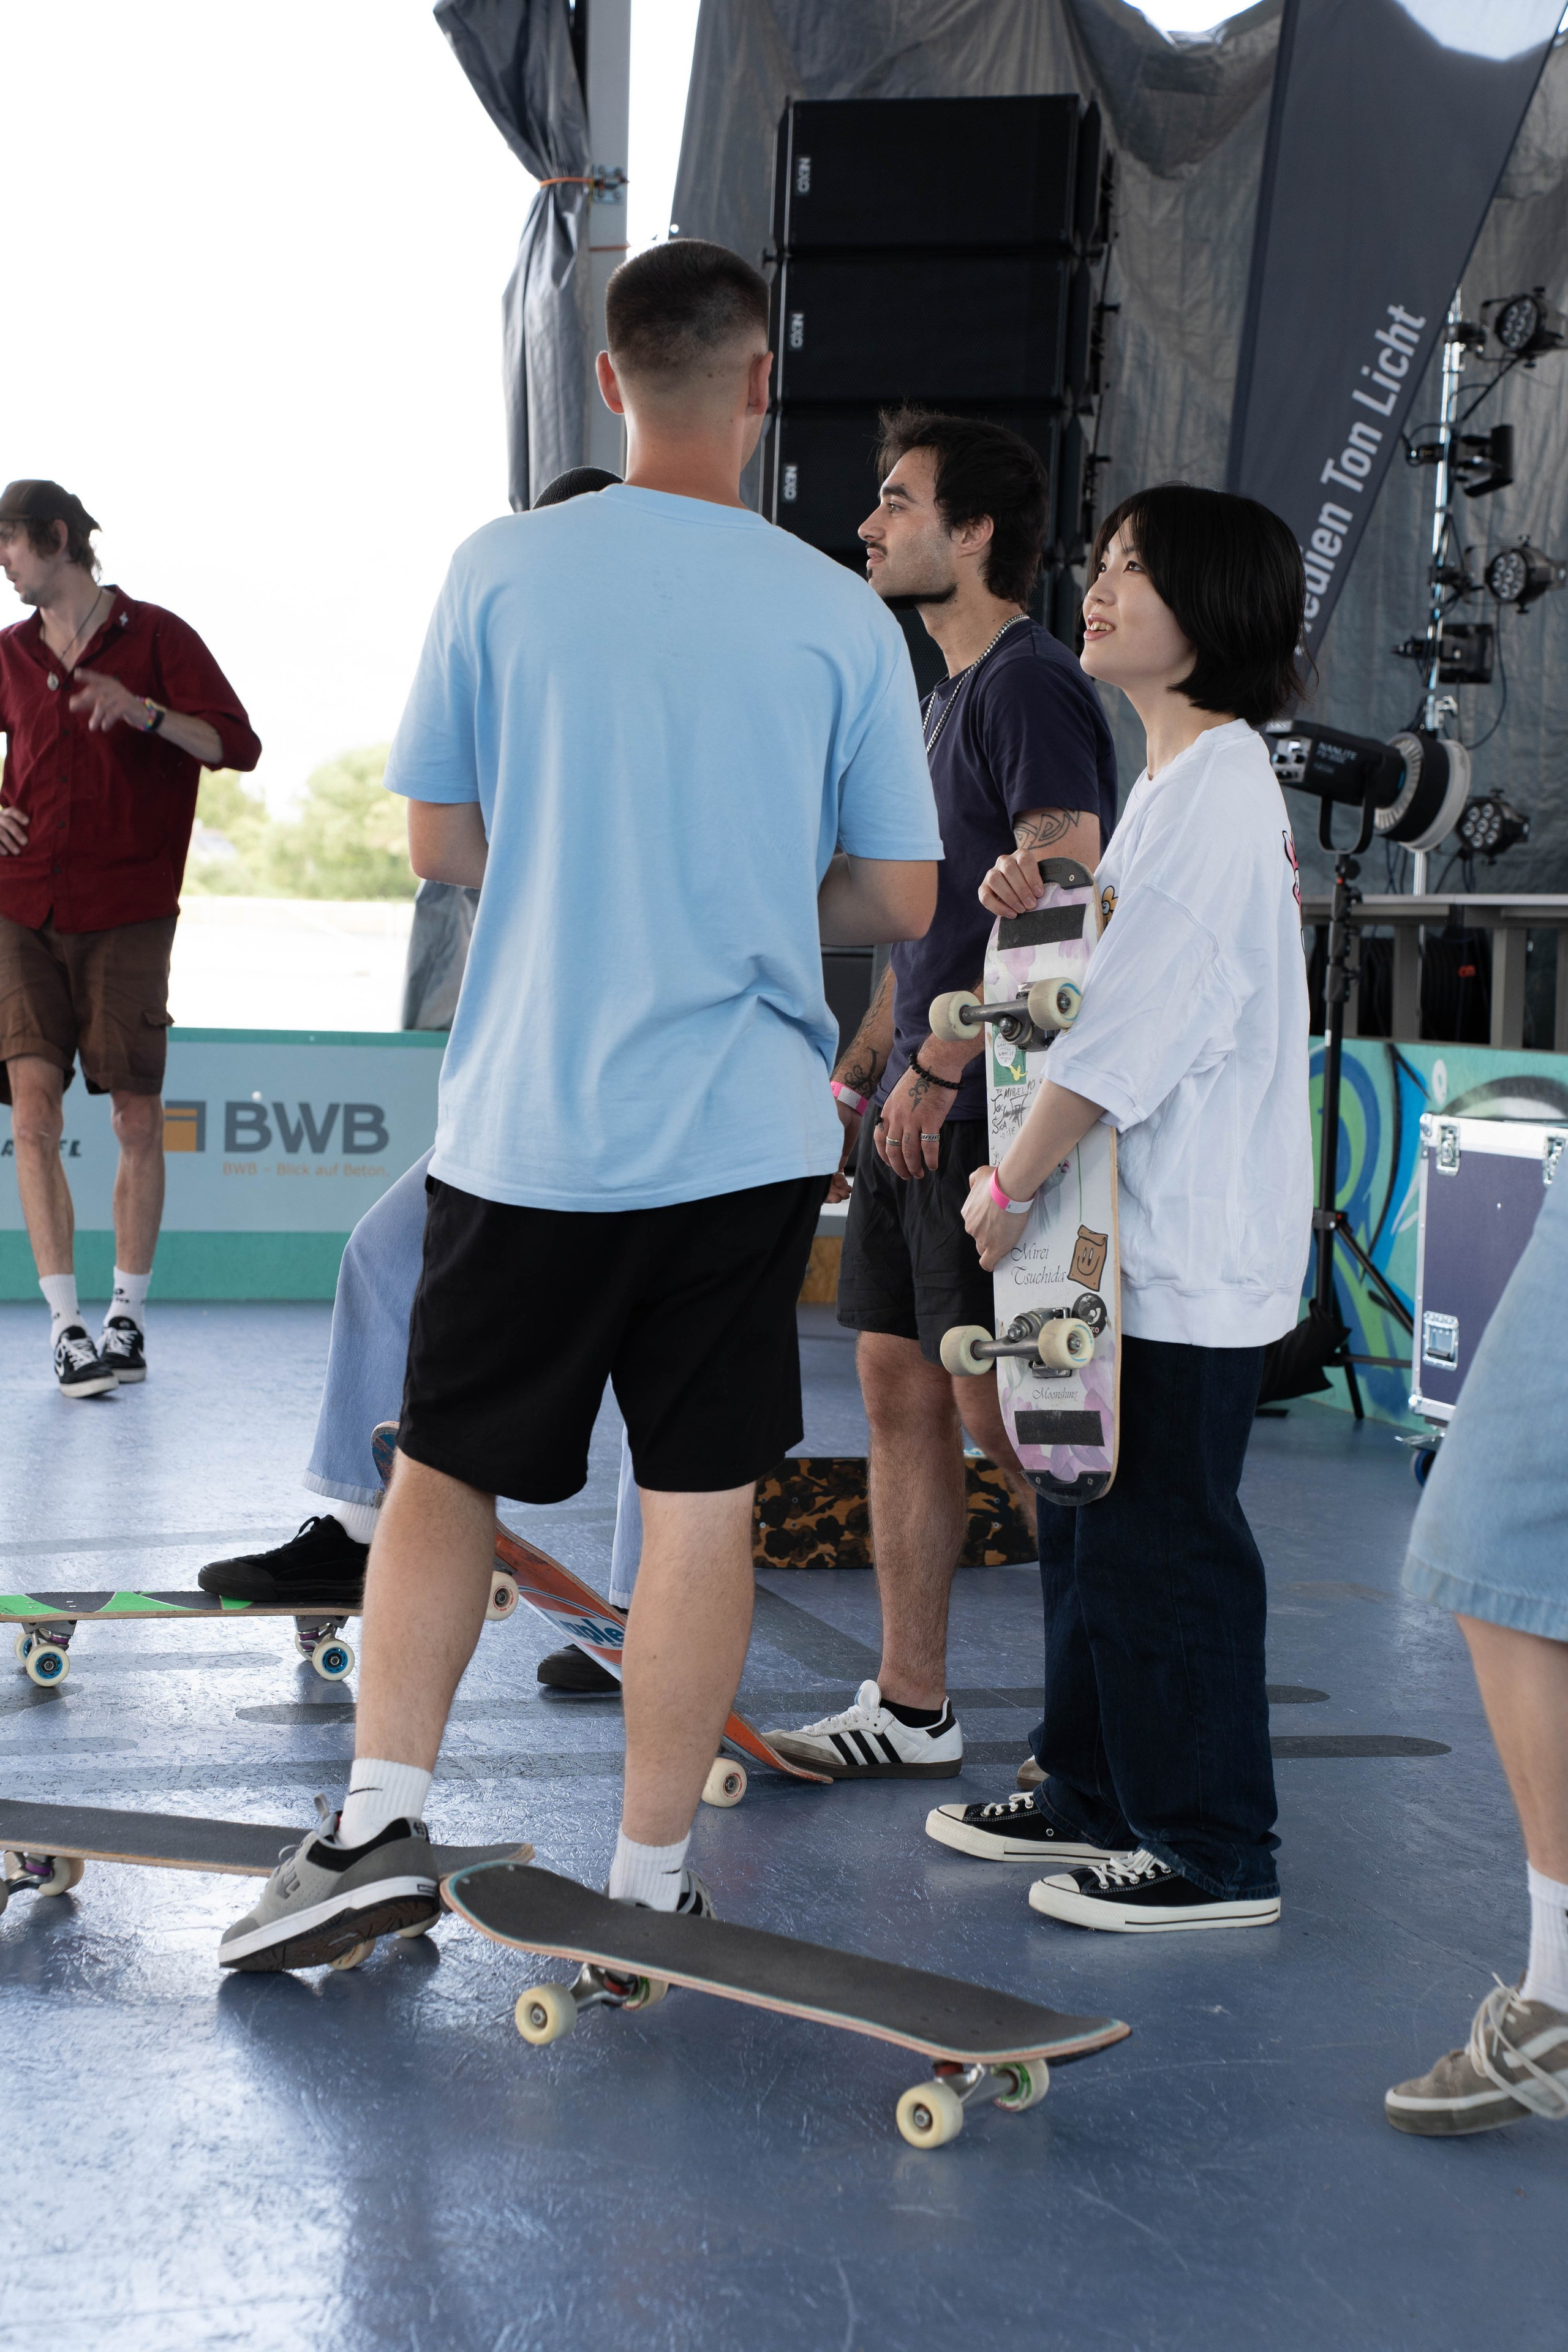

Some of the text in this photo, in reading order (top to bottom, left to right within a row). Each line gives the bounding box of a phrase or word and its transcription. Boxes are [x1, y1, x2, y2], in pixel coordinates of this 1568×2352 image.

[797, 157, 811, 192] NEXO
[791, 314, 804, 349] NEXO
[784, 466, 797, 500] NEXO
[1294, 304, 1427, 656] edien Ton Licht
[224, 1101, 390, 1155] BWB
[222, 1162, 258, 1176] BWB
[277, 1162, 310, 1177] Blick
[315, 1163, 339, 1177] auf
[1011, 1243, 1050, 1261] Mirei
[1011, 1265, 1066, 1285] Tsuchida
